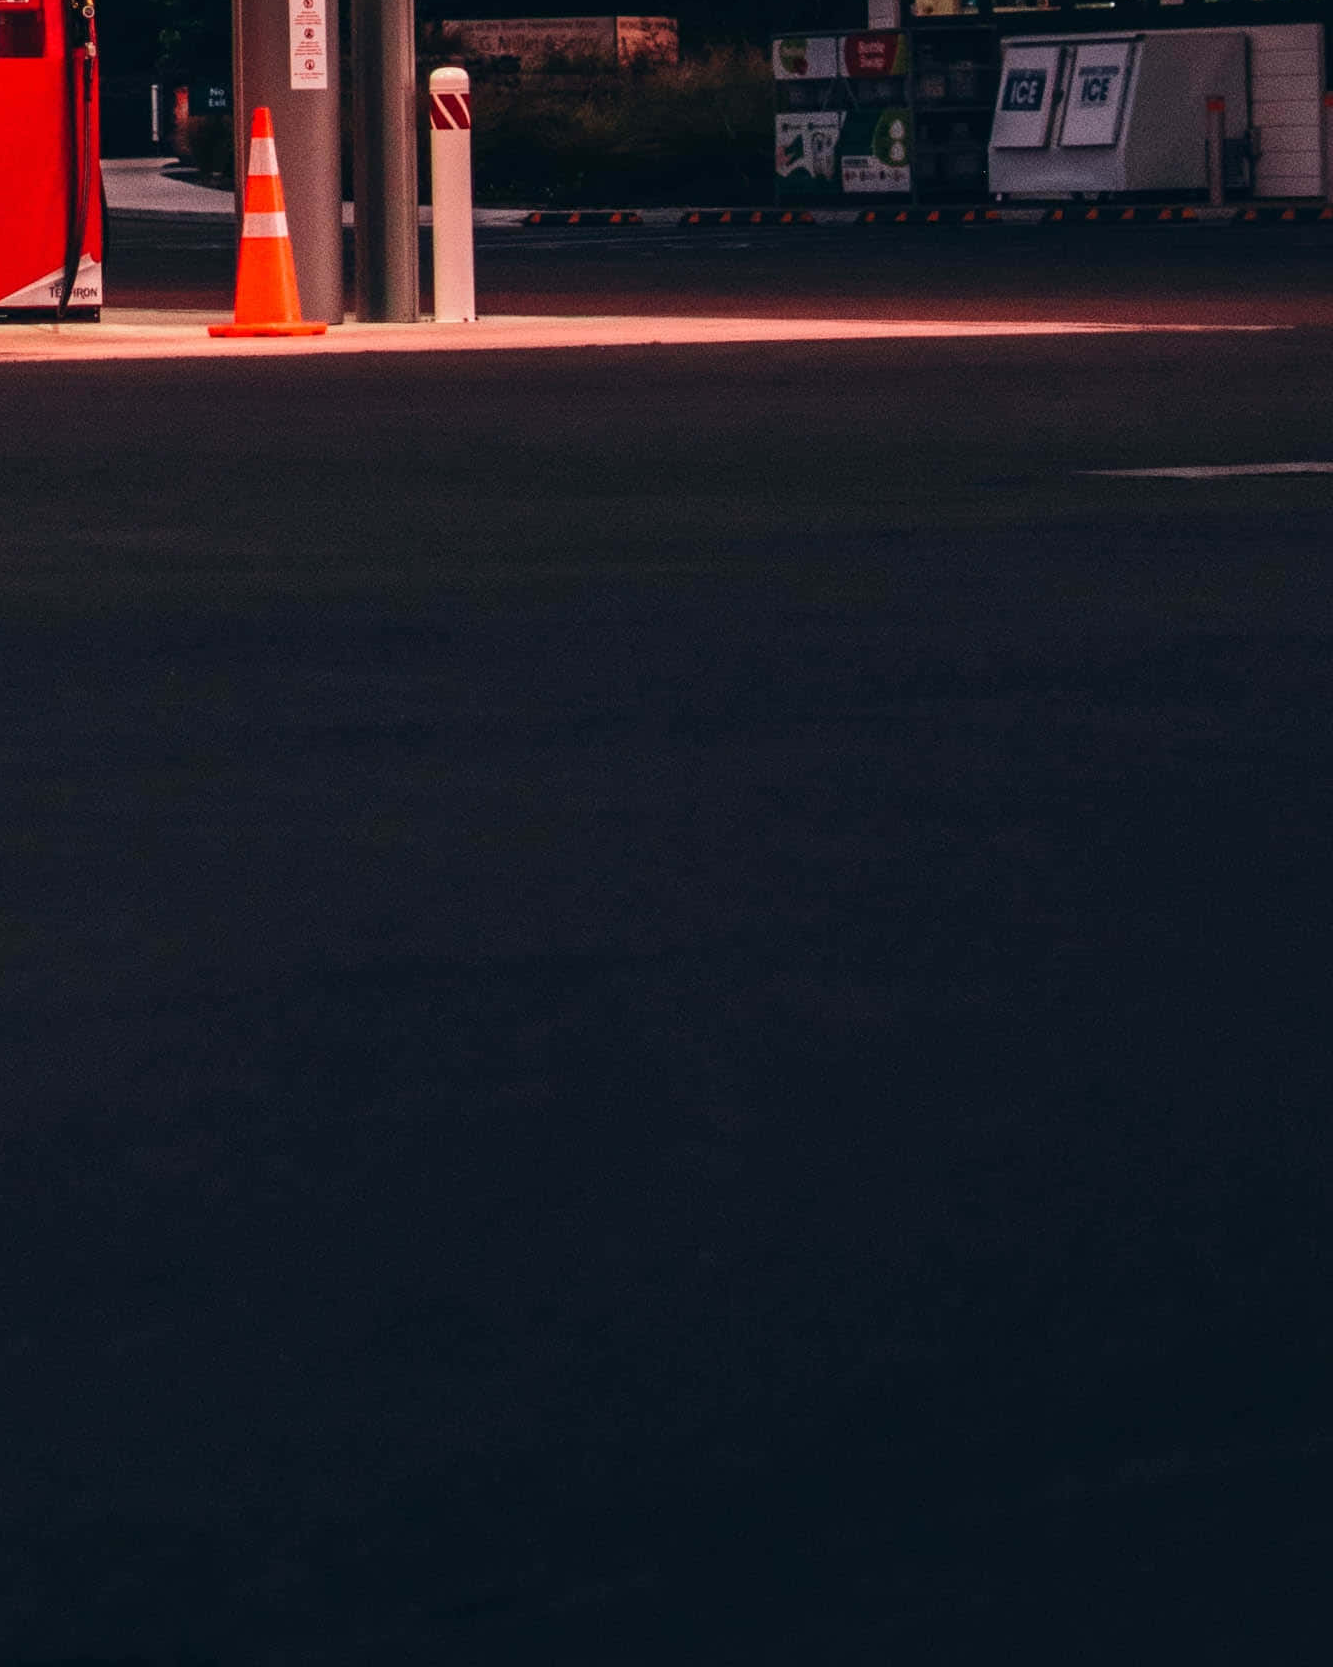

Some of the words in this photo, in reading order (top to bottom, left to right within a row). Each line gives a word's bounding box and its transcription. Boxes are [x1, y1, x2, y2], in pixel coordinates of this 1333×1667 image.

[1010, 78, 1040, 105] ICE
[1082, 77, 1111, 102] ICE
[48, 286, 98, 300] TERON
